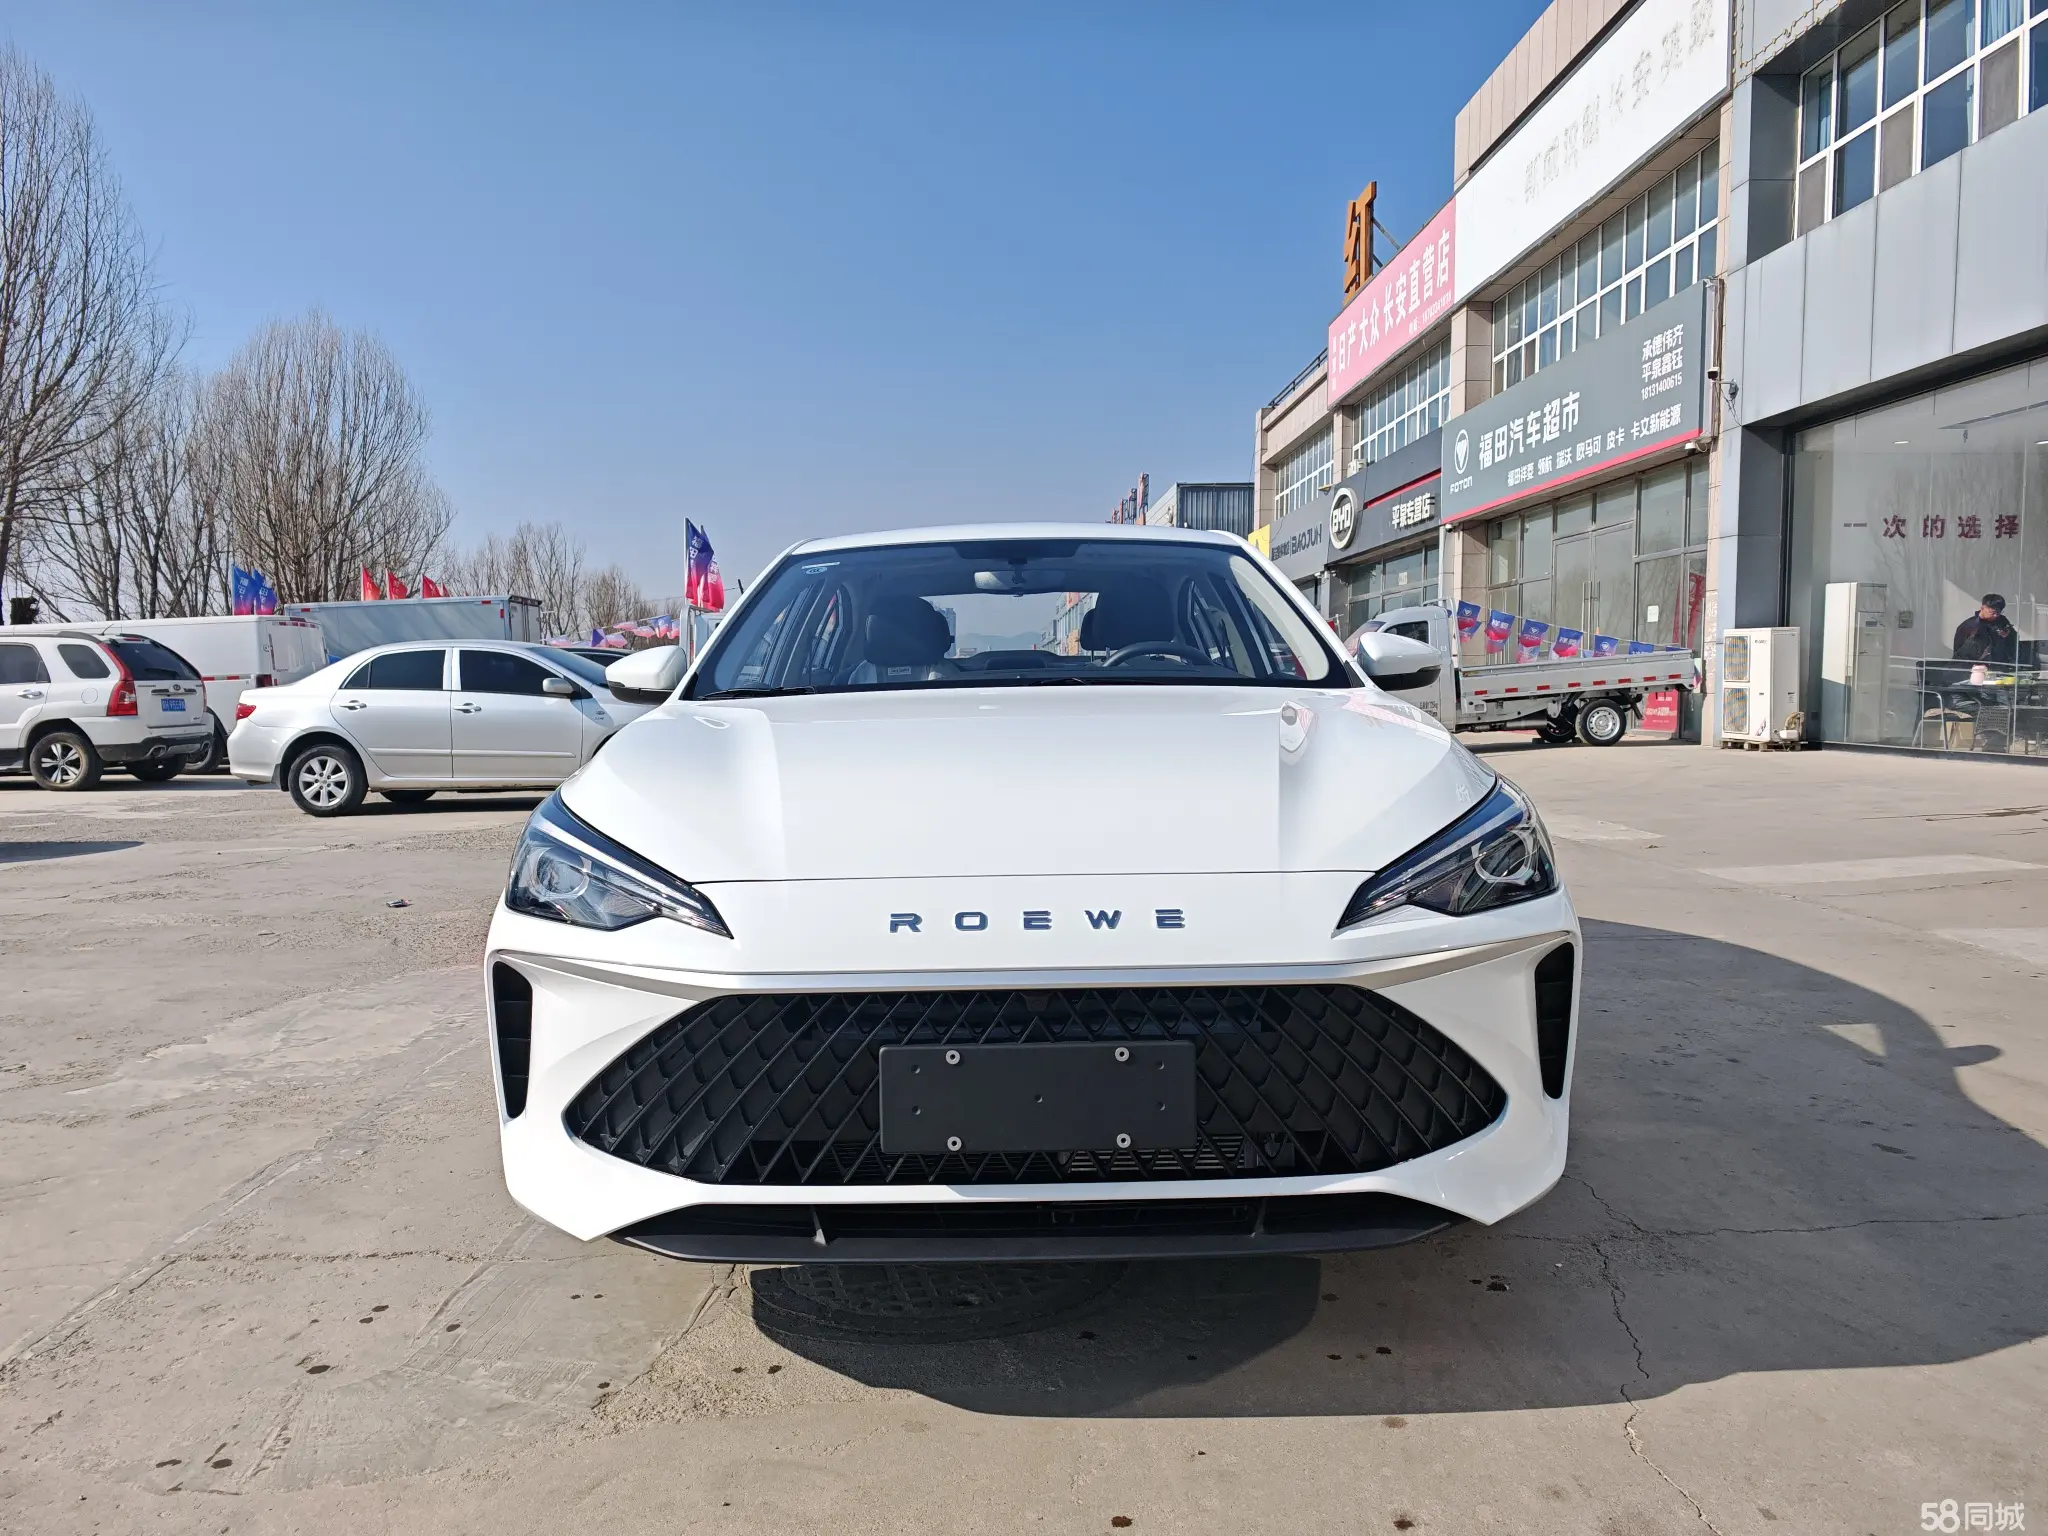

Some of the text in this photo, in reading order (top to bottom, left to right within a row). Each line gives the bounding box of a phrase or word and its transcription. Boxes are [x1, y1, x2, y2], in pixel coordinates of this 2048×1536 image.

[1641, 372, 1682, 400] 18131400615
[1479, 391, 1580, 470] 福田汽车超市
[1606, 426, 1625, 450] 皮卡
[1630, 403, 1682, 440] 卡文新能源
[1333, 502, 1351, 533] BYD
[1844, 514, 2019, 539] 一次的选择
[889, 908, 1186, 933] ROEWE
